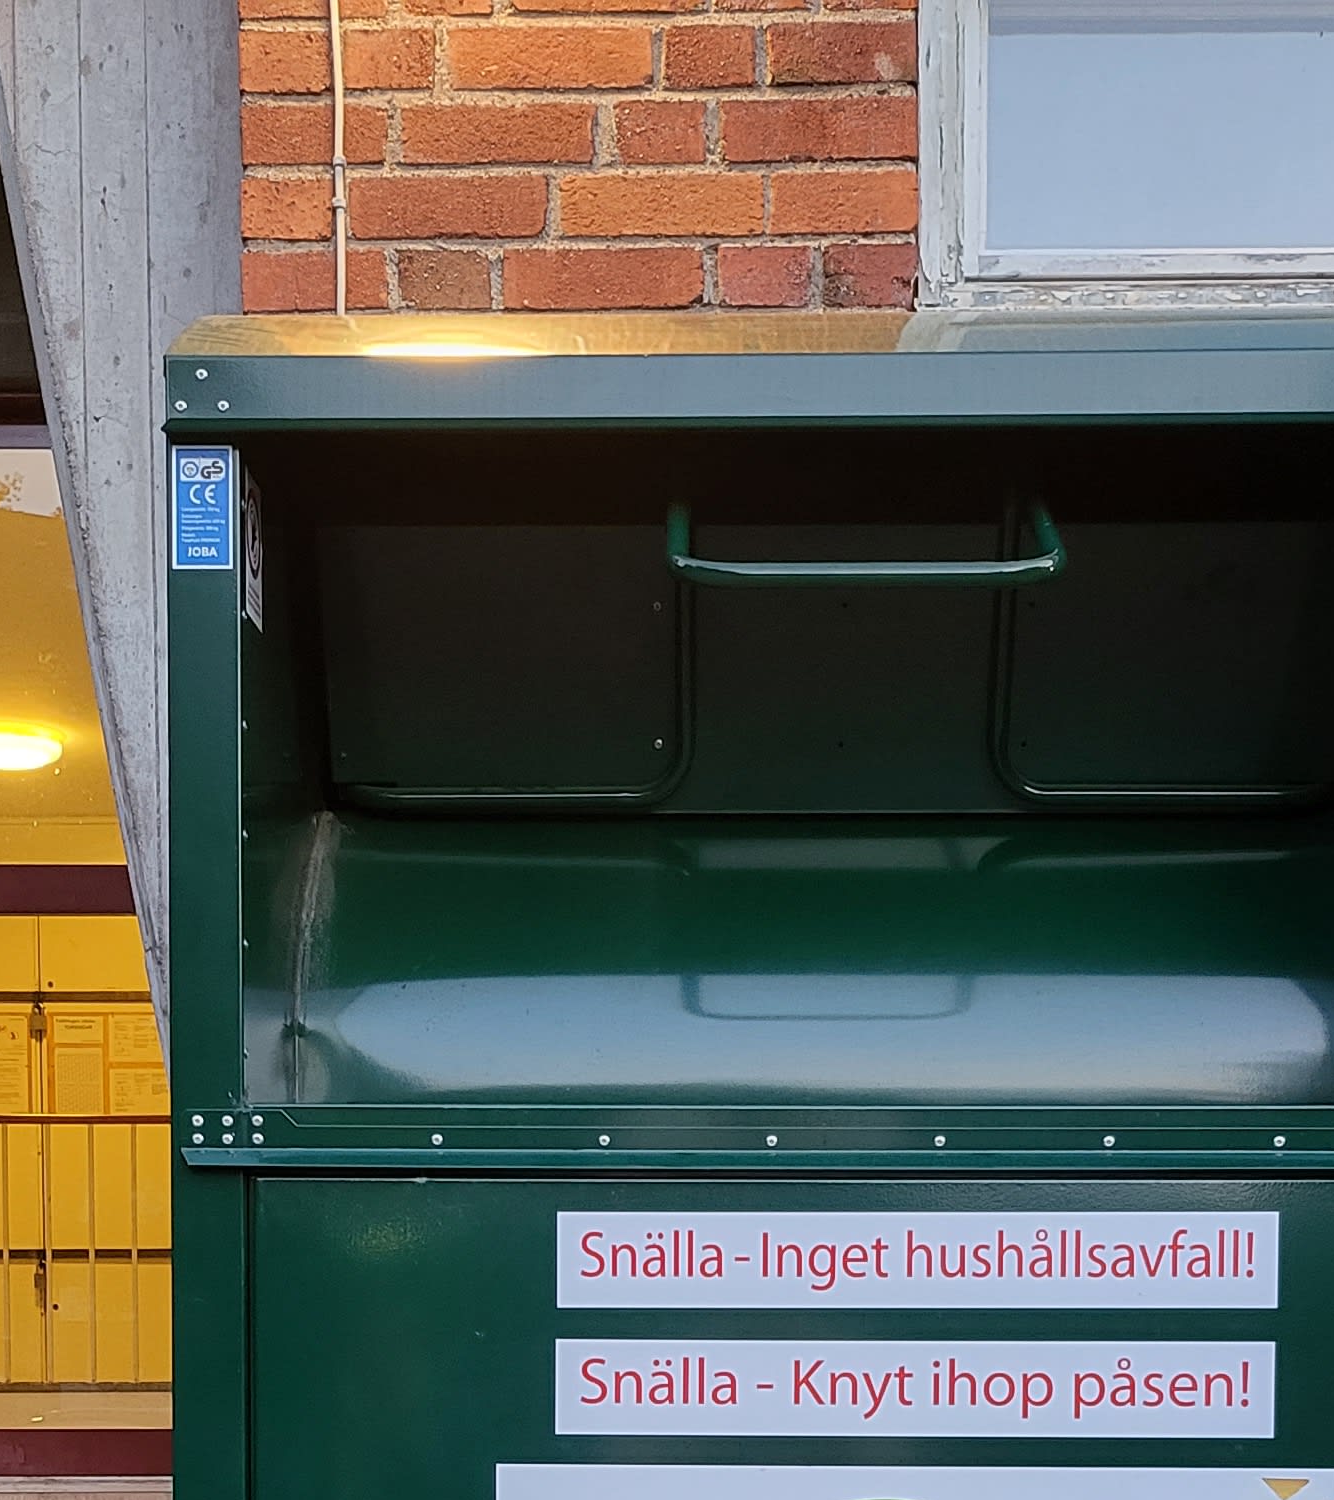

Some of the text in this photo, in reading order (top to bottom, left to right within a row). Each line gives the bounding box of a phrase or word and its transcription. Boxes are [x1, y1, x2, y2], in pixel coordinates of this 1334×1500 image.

[187, 547, 218, 558] JOBA
[907, 1229, 1254, 1279] hushållsavfall!
[581, 1357, 737, 1406] Snälla
[793, 1360, 914, 1420] Knyt
[932, 1359, 1054, 1419] ihop
[1074, 1358, 1249, 1420] påsen!
